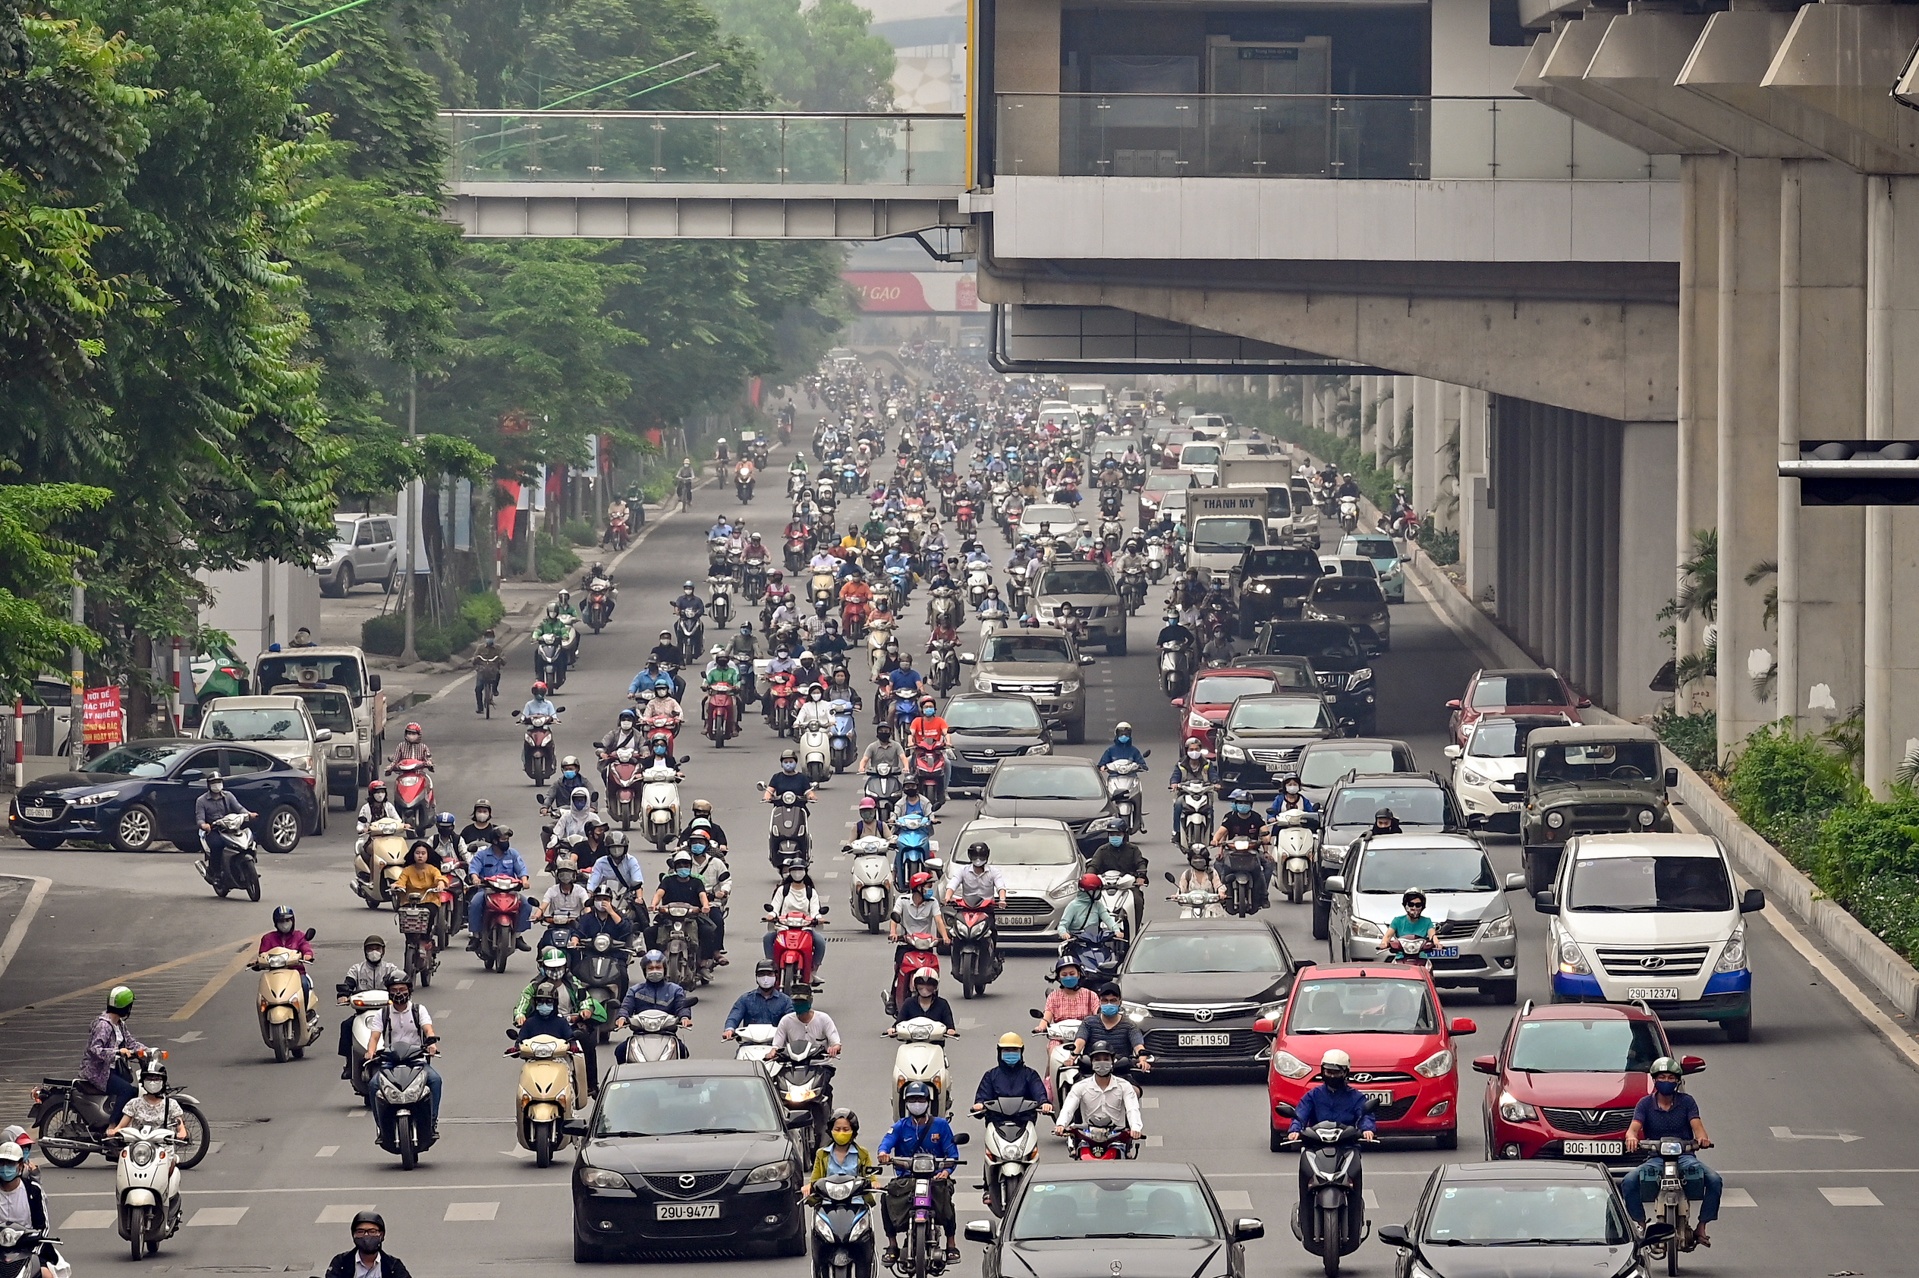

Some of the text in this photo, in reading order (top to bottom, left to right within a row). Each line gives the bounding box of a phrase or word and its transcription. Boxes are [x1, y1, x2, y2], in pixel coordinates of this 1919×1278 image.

[1179, 1034, 1229, 1046] 30F-119.50
[1565, 1142, 1622, 1154] 30G-110.03
[660, 1205, 716, 1219] 29U-9477
